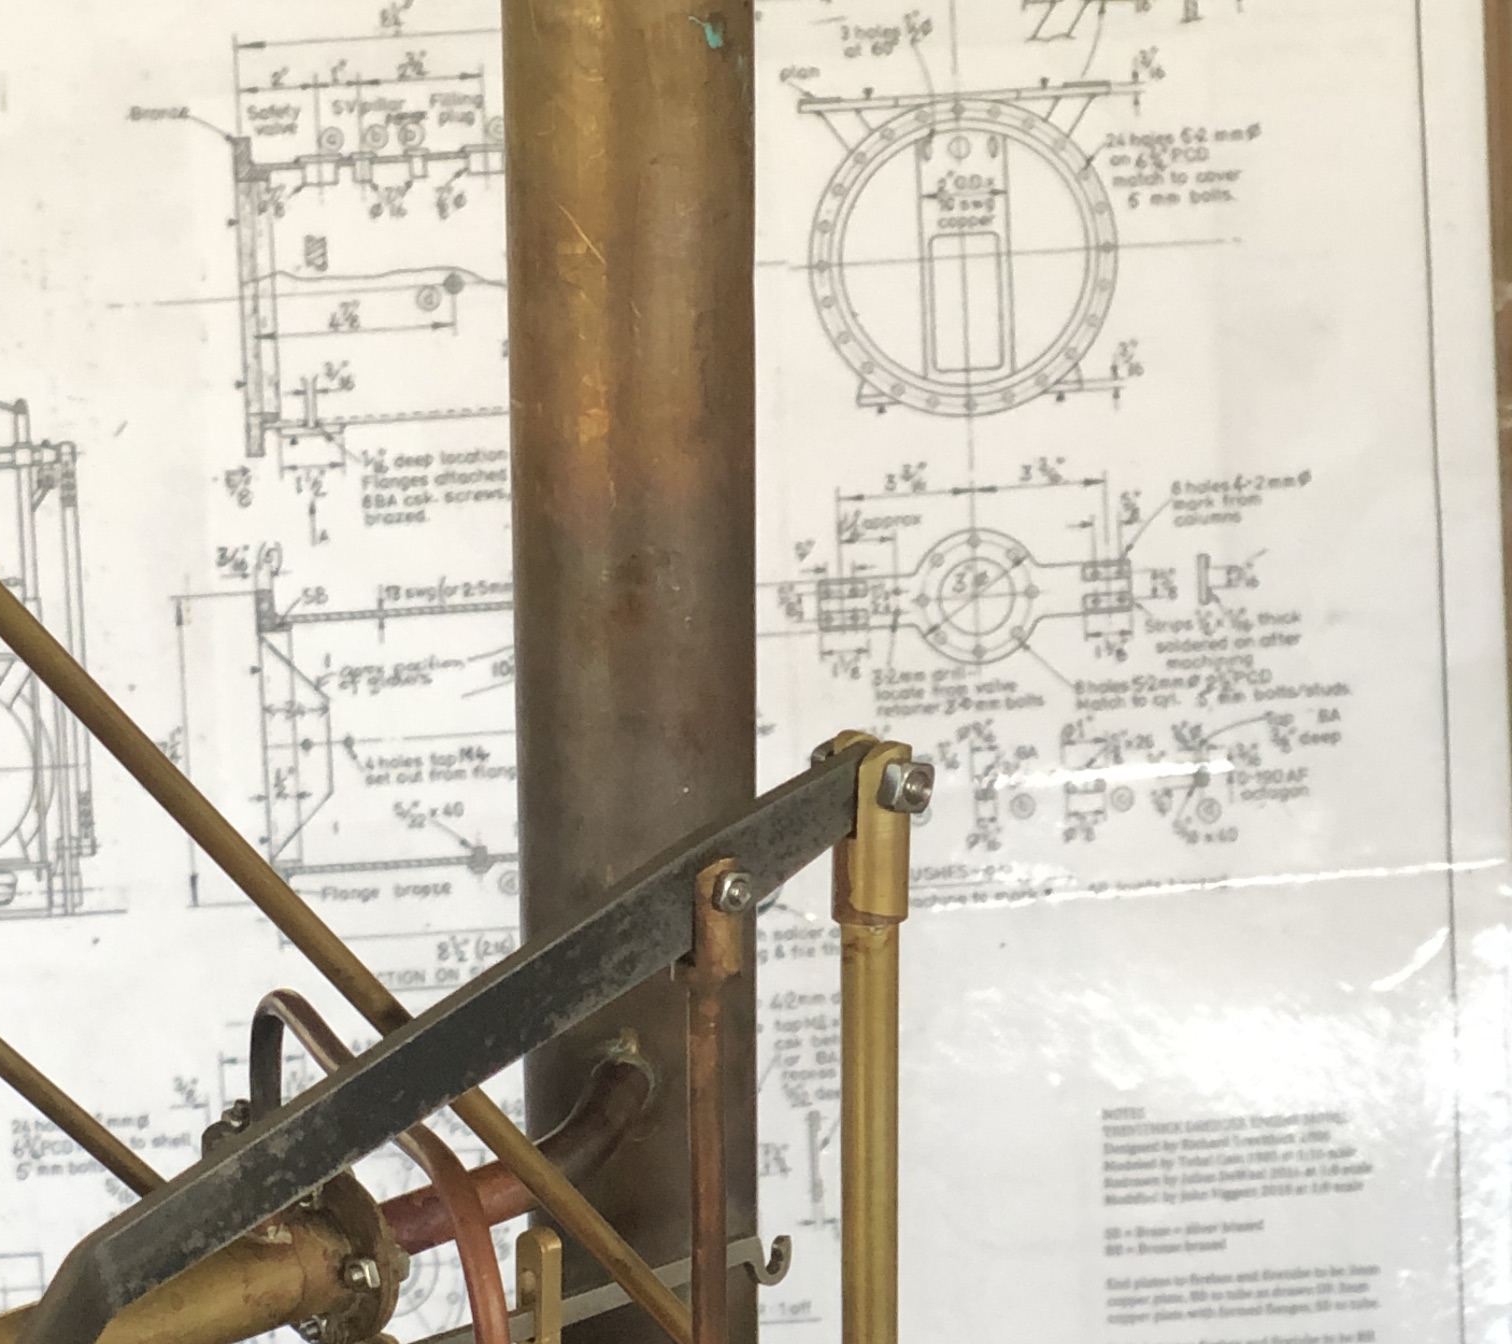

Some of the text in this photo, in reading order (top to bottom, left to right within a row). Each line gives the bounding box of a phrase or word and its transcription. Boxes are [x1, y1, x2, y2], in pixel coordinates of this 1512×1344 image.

[780, 65, 821, 82] plan
[1109, 154, 1131, 167] on
[1112, 170, 1242, 187] match to cover
[937, 214, 996, 229] copper
[394, 454, 434, 469] deep
[361, 474, 429, 492] Flanges
[1185, 479, 1229, 494] holes
[1173, 494, 1263, 511] mark from
[1174, 511, 1242, 528] columns
[1155, 637, 1229, 654] soldered
[1234, 636, 1255, 649] on
[875, 687, 925, 700] locate
[975, 680, 1019, 695] valve
[1087, 679, 1129, 694] holes
[1132, 694, 1148, 709] to
[1299, 731, 1343, 746] deep
[378, 754, 423, 769] holes
[365, 773, 390, 786] set
[396, 770, 423, 784] out
[429, 767, 467, 782] from
[320, 885, 380, 904] Flange
